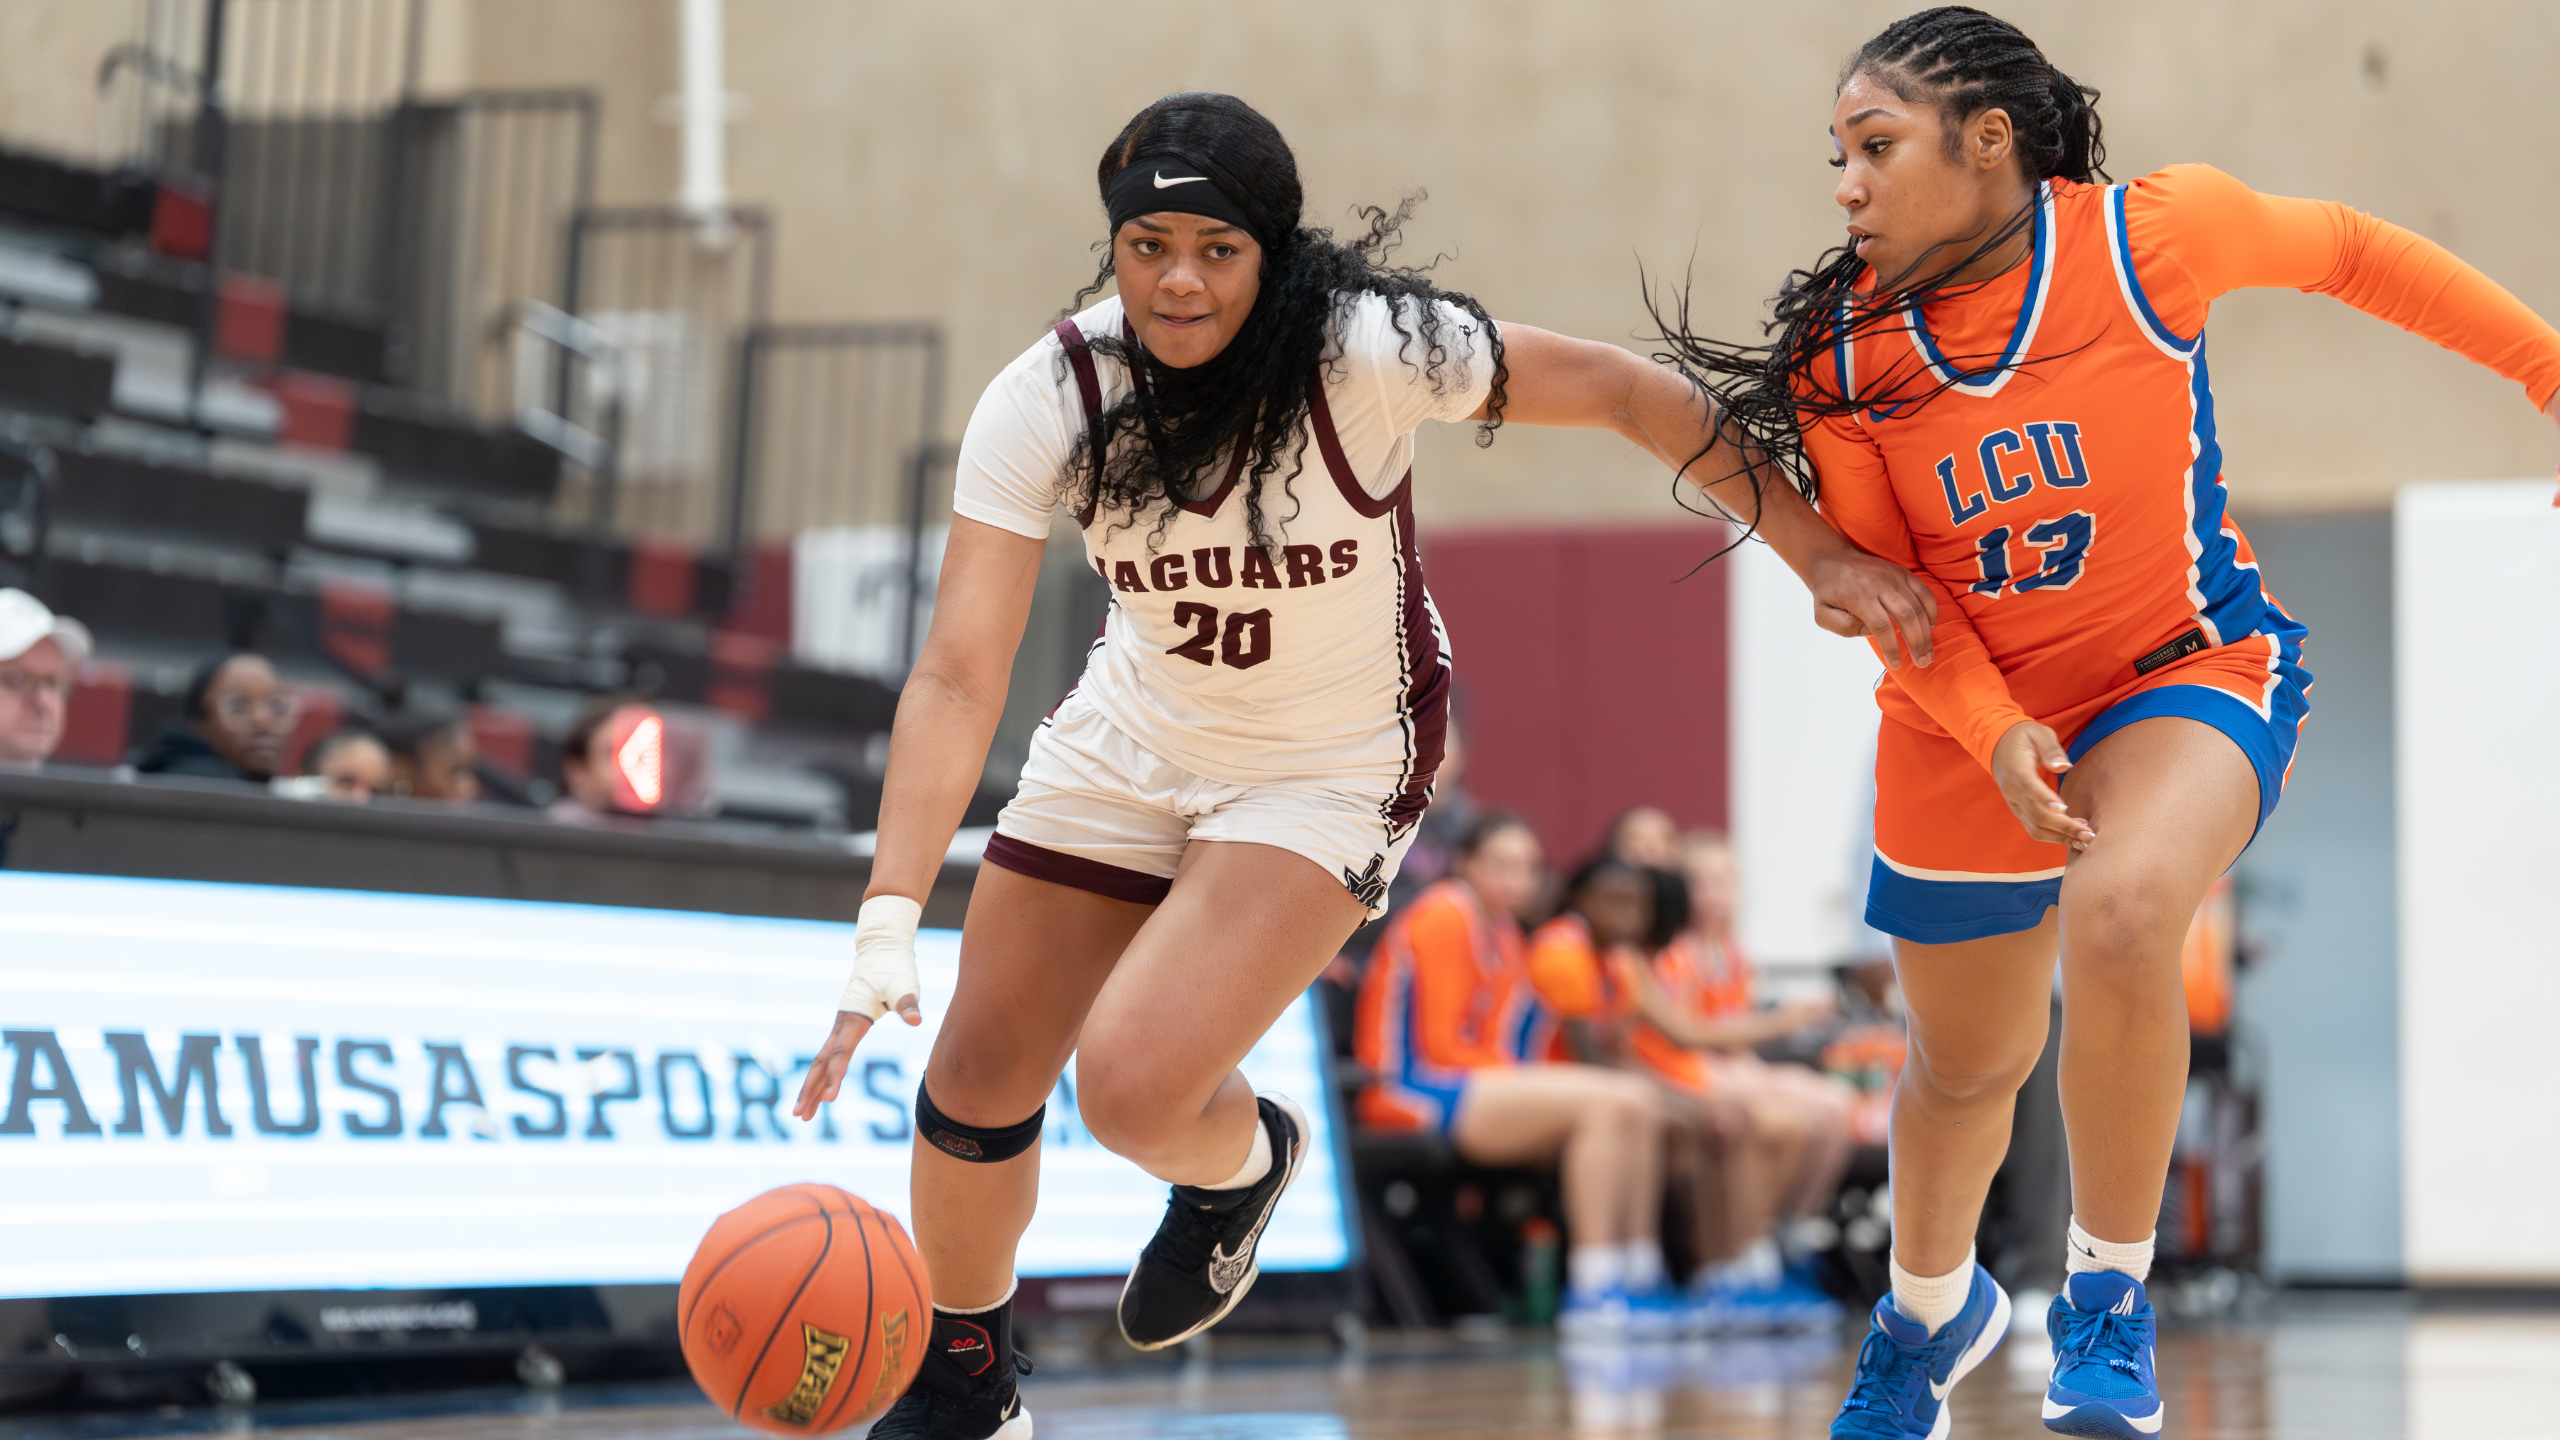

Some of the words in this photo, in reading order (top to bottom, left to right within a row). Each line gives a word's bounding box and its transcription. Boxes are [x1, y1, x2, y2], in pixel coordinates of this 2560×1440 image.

[1935, 421, 2091, 528] LCU
[1968, 509, 2096, 599] 13
[1165, 601, 1274, 670] 20
[2184, 640, 2199, 655] M
